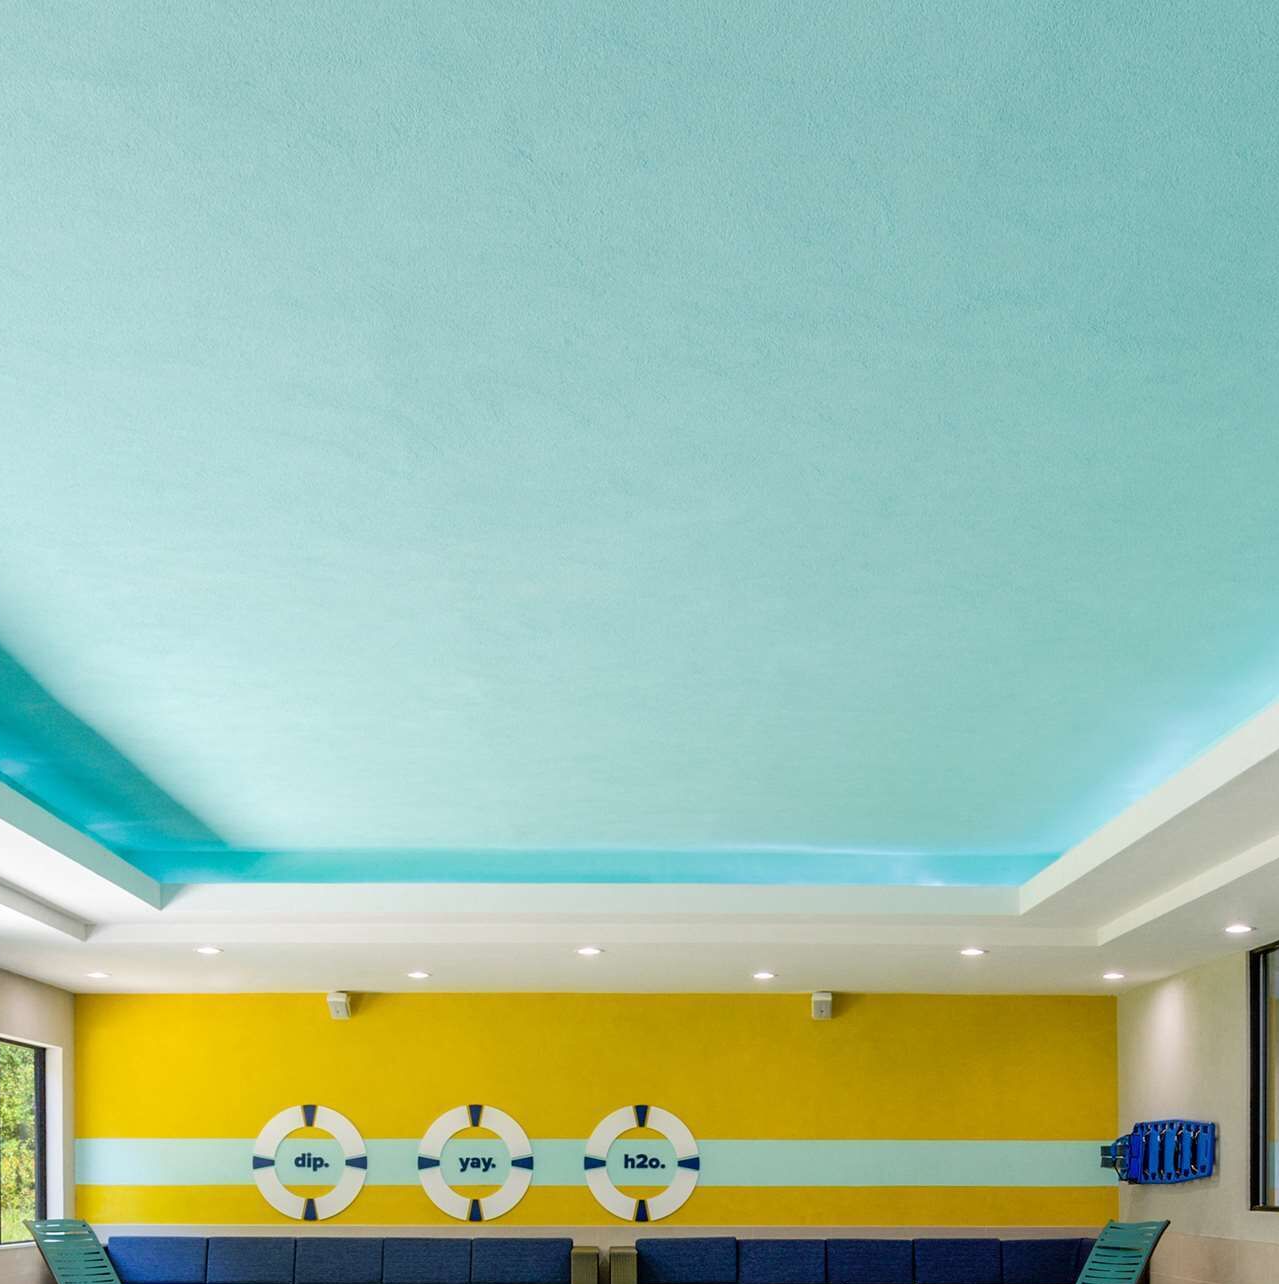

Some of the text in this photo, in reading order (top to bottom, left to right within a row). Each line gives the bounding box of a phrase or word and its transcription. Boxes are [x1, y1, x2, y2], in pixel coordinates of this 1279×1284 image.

[294, 1152, 330, 1172] dip.
[459, 1157, 496, 1172] yay.
[624, 1154, 666, 1169] h2o.
